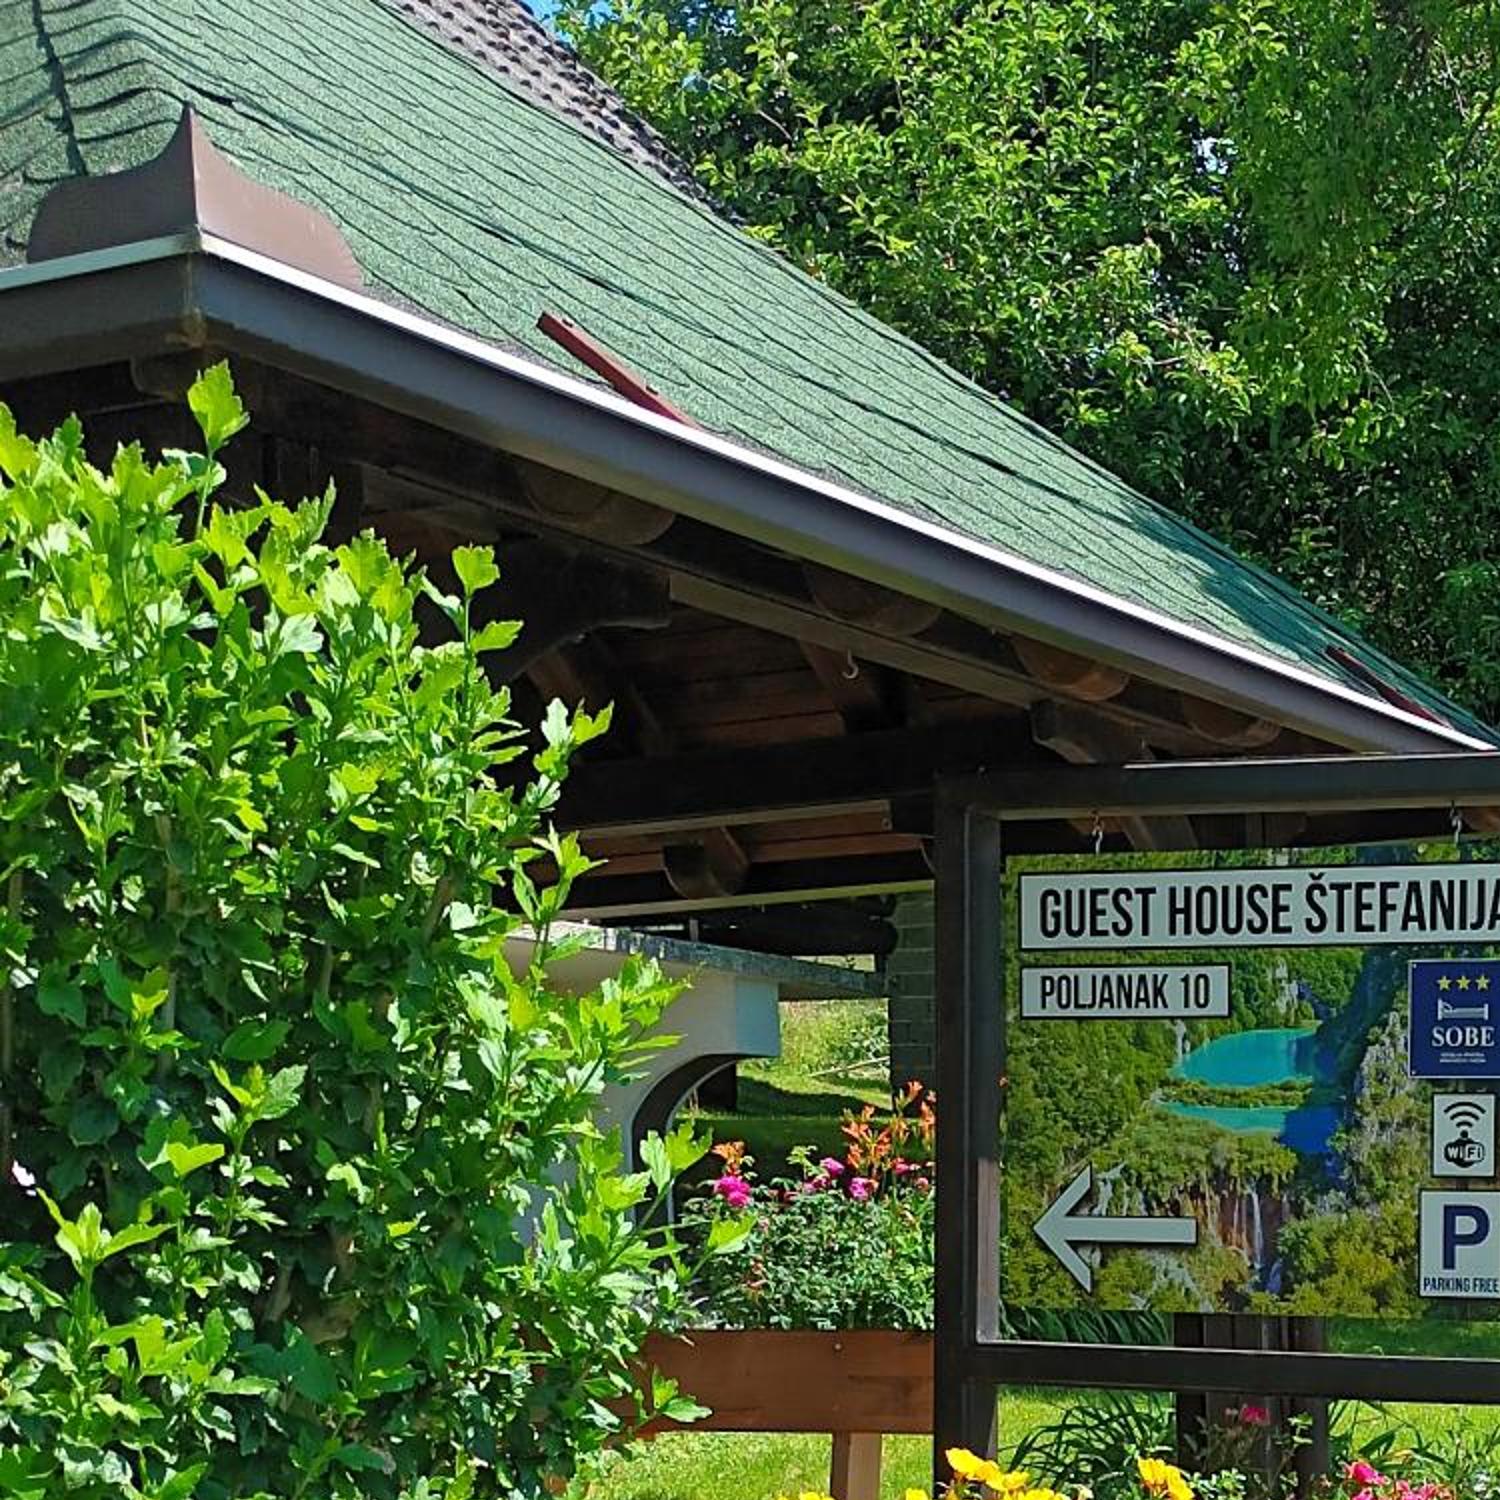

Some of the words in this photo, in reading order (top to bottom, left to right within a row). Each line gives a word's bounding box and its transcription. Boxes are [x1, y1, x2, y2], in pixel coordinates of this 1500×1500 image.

[1039, 886, 1157, 939] GUEST
[1169, 883, 1293, 936] HOUSE
[1041, 973, 1169, 1010] POLJANAK
[1180, 973, 1210, 1009] 10
[1431, 1026, 1495, 1048] SOBE
[1442, 1204, 1490, 1270] P
[1423, 1277, 1470, 1292] PARKING
[1473, 1277, 1499, 1293] FREE
